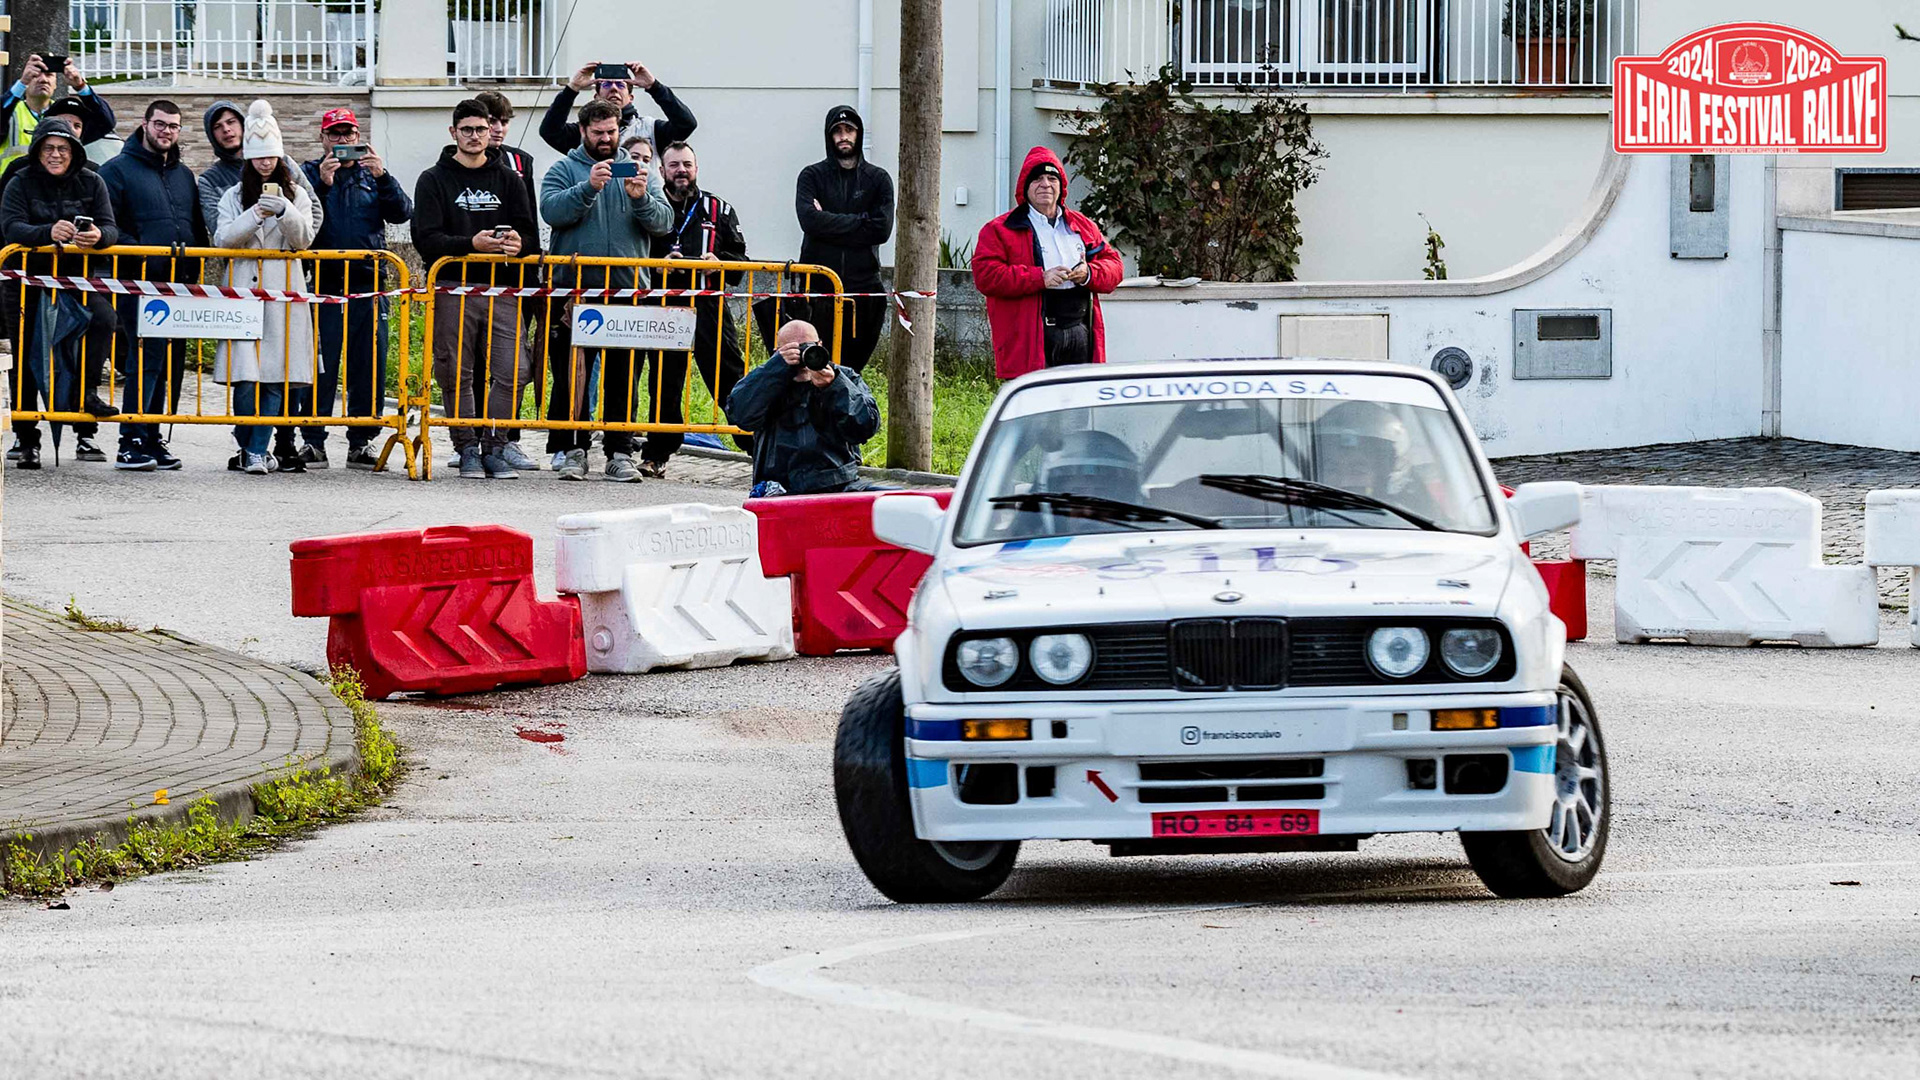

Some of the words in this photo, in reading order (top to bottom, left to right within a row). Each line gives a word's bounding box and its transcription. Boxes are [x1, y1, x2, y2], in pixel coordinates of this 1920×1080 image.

[1098, 381, 1277, 401] SOLIWODA
[1288, 380, 1350, 395] S.A.
[1202, 729, 1282, 740] franciscoruivo
[1161, 815, 1199, 834] RO
[1225, 814, 1254, 832] 84
[1280, 813, 1310, 832] 69
